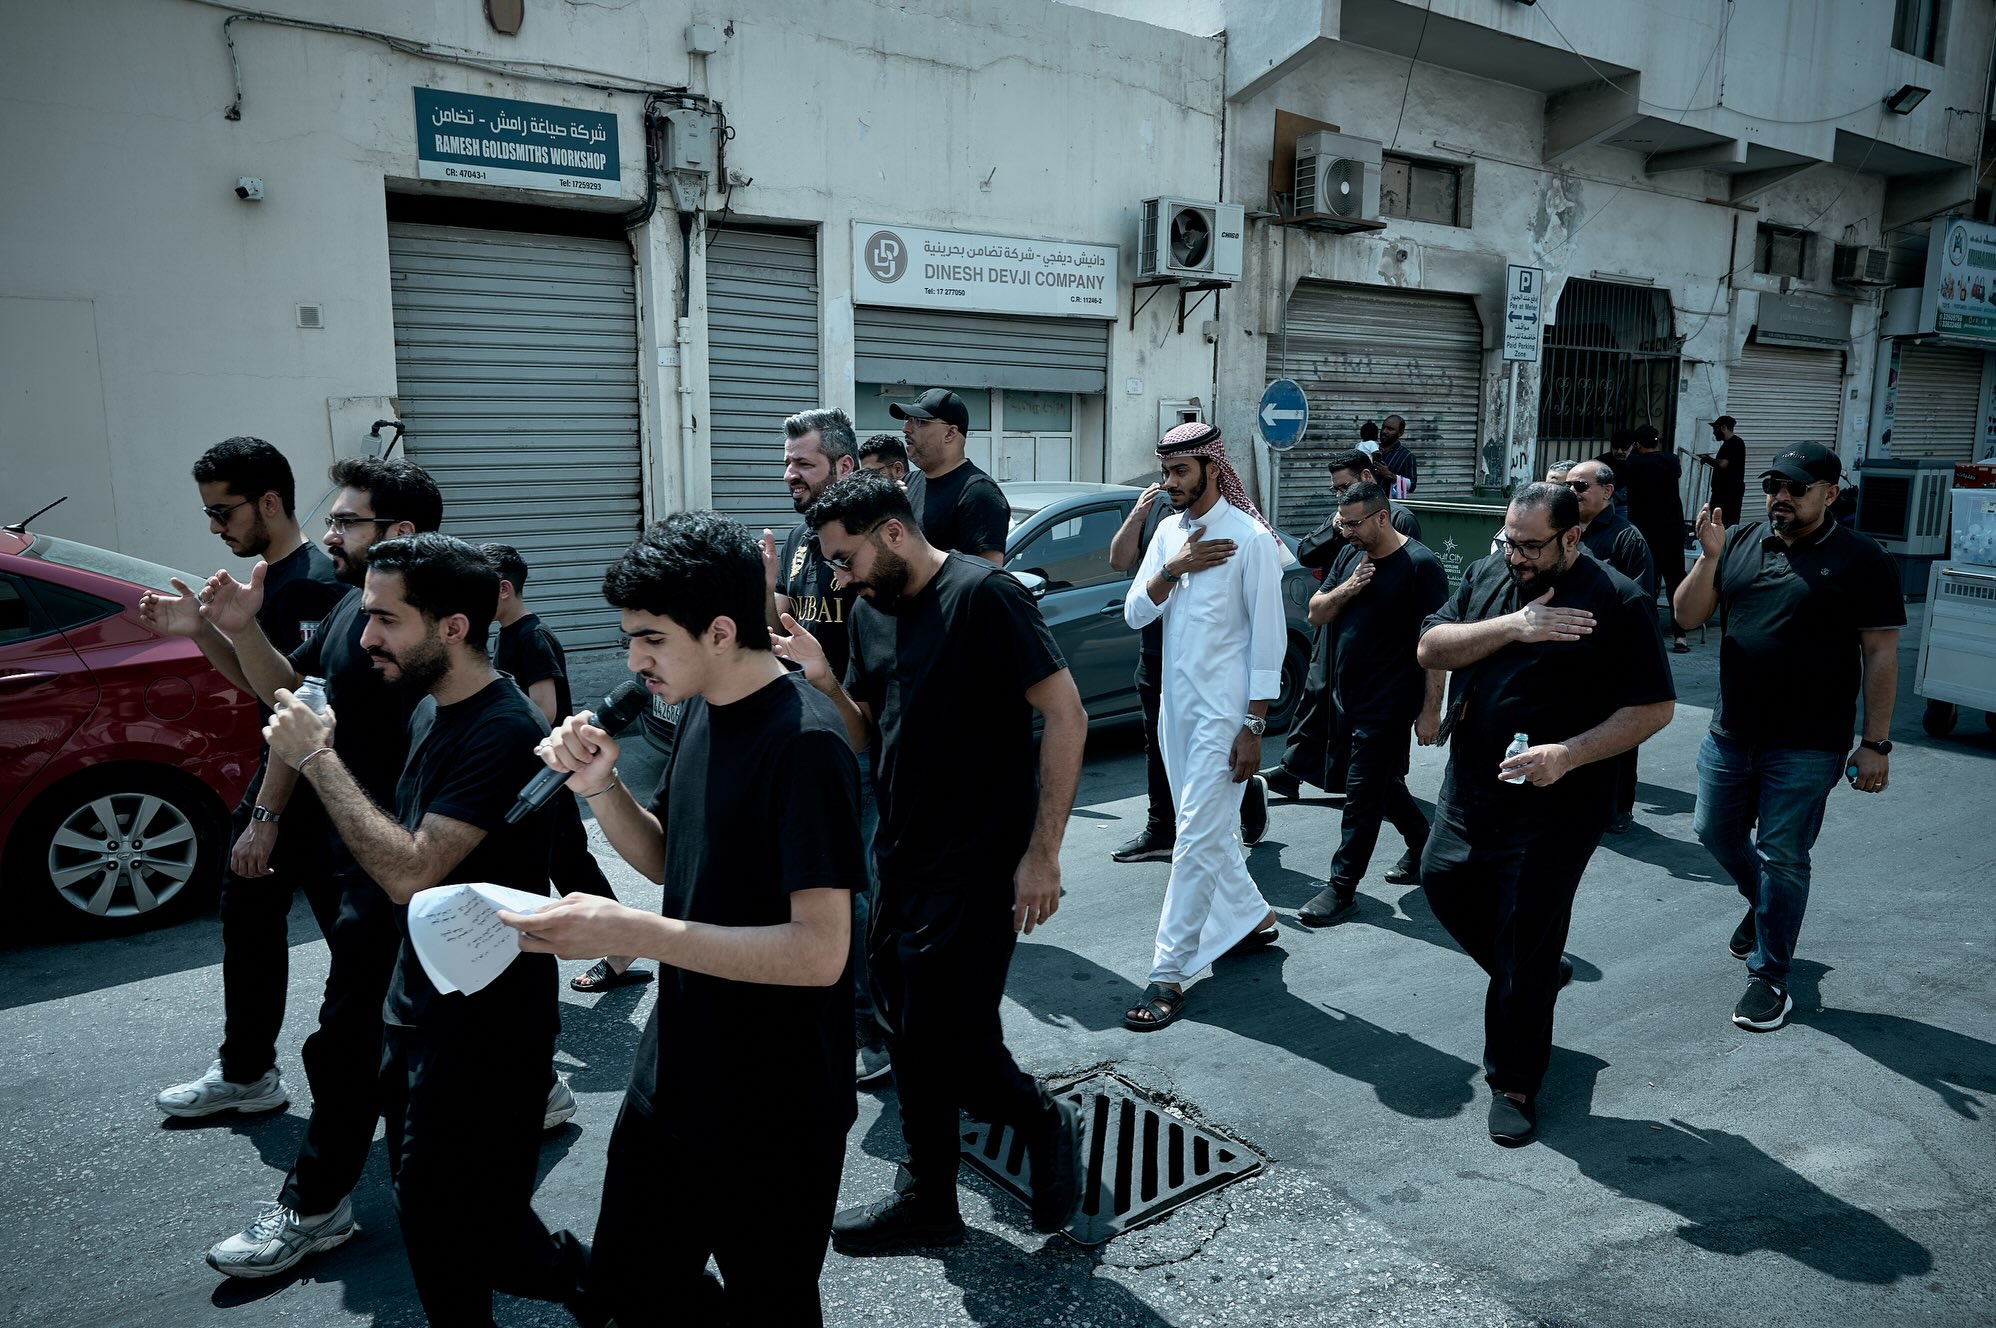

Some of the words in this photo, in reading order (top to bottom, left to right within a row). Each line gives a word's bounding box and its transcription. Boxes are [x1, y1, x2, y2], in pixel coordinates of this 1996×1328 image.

[431, 106, 475, 126] تضامن
[490, 110, 527, 136] رامش
[530, 116, 567, 139] صياغة
[571, 122, 606, 145] شركة
[435, 134, 480, 157] RAMESH
[482, 139, 549, 164] GOLDSMITHS
[550, 146, 607, 170] WORKSHOP
[445, 168, 458, 177] CR:
[459, 169, 486, 179] 47043-1
[559, 179, 571, 188] Tel:
[572, 180, 602, 190] 17259293
[924, 240, 965, 258] بحرينية
[966, 246, 1002, 258] تضامن
[1004, 247, 1035, 262] شركة
[1043, 251, 1072, 268] ديفجي
[1074, 251, 1105, 268] دانيش
[924, 264, 984, 282] DINESH
[988, 267, 1030, 286] DEVJI
[1034, 271, 1105, 290] COMPANY
[1510, 302, 1518, 310] Pay
[1518, 342, 1535, 351] Parking
[1449, 553, 1464, 564] City
